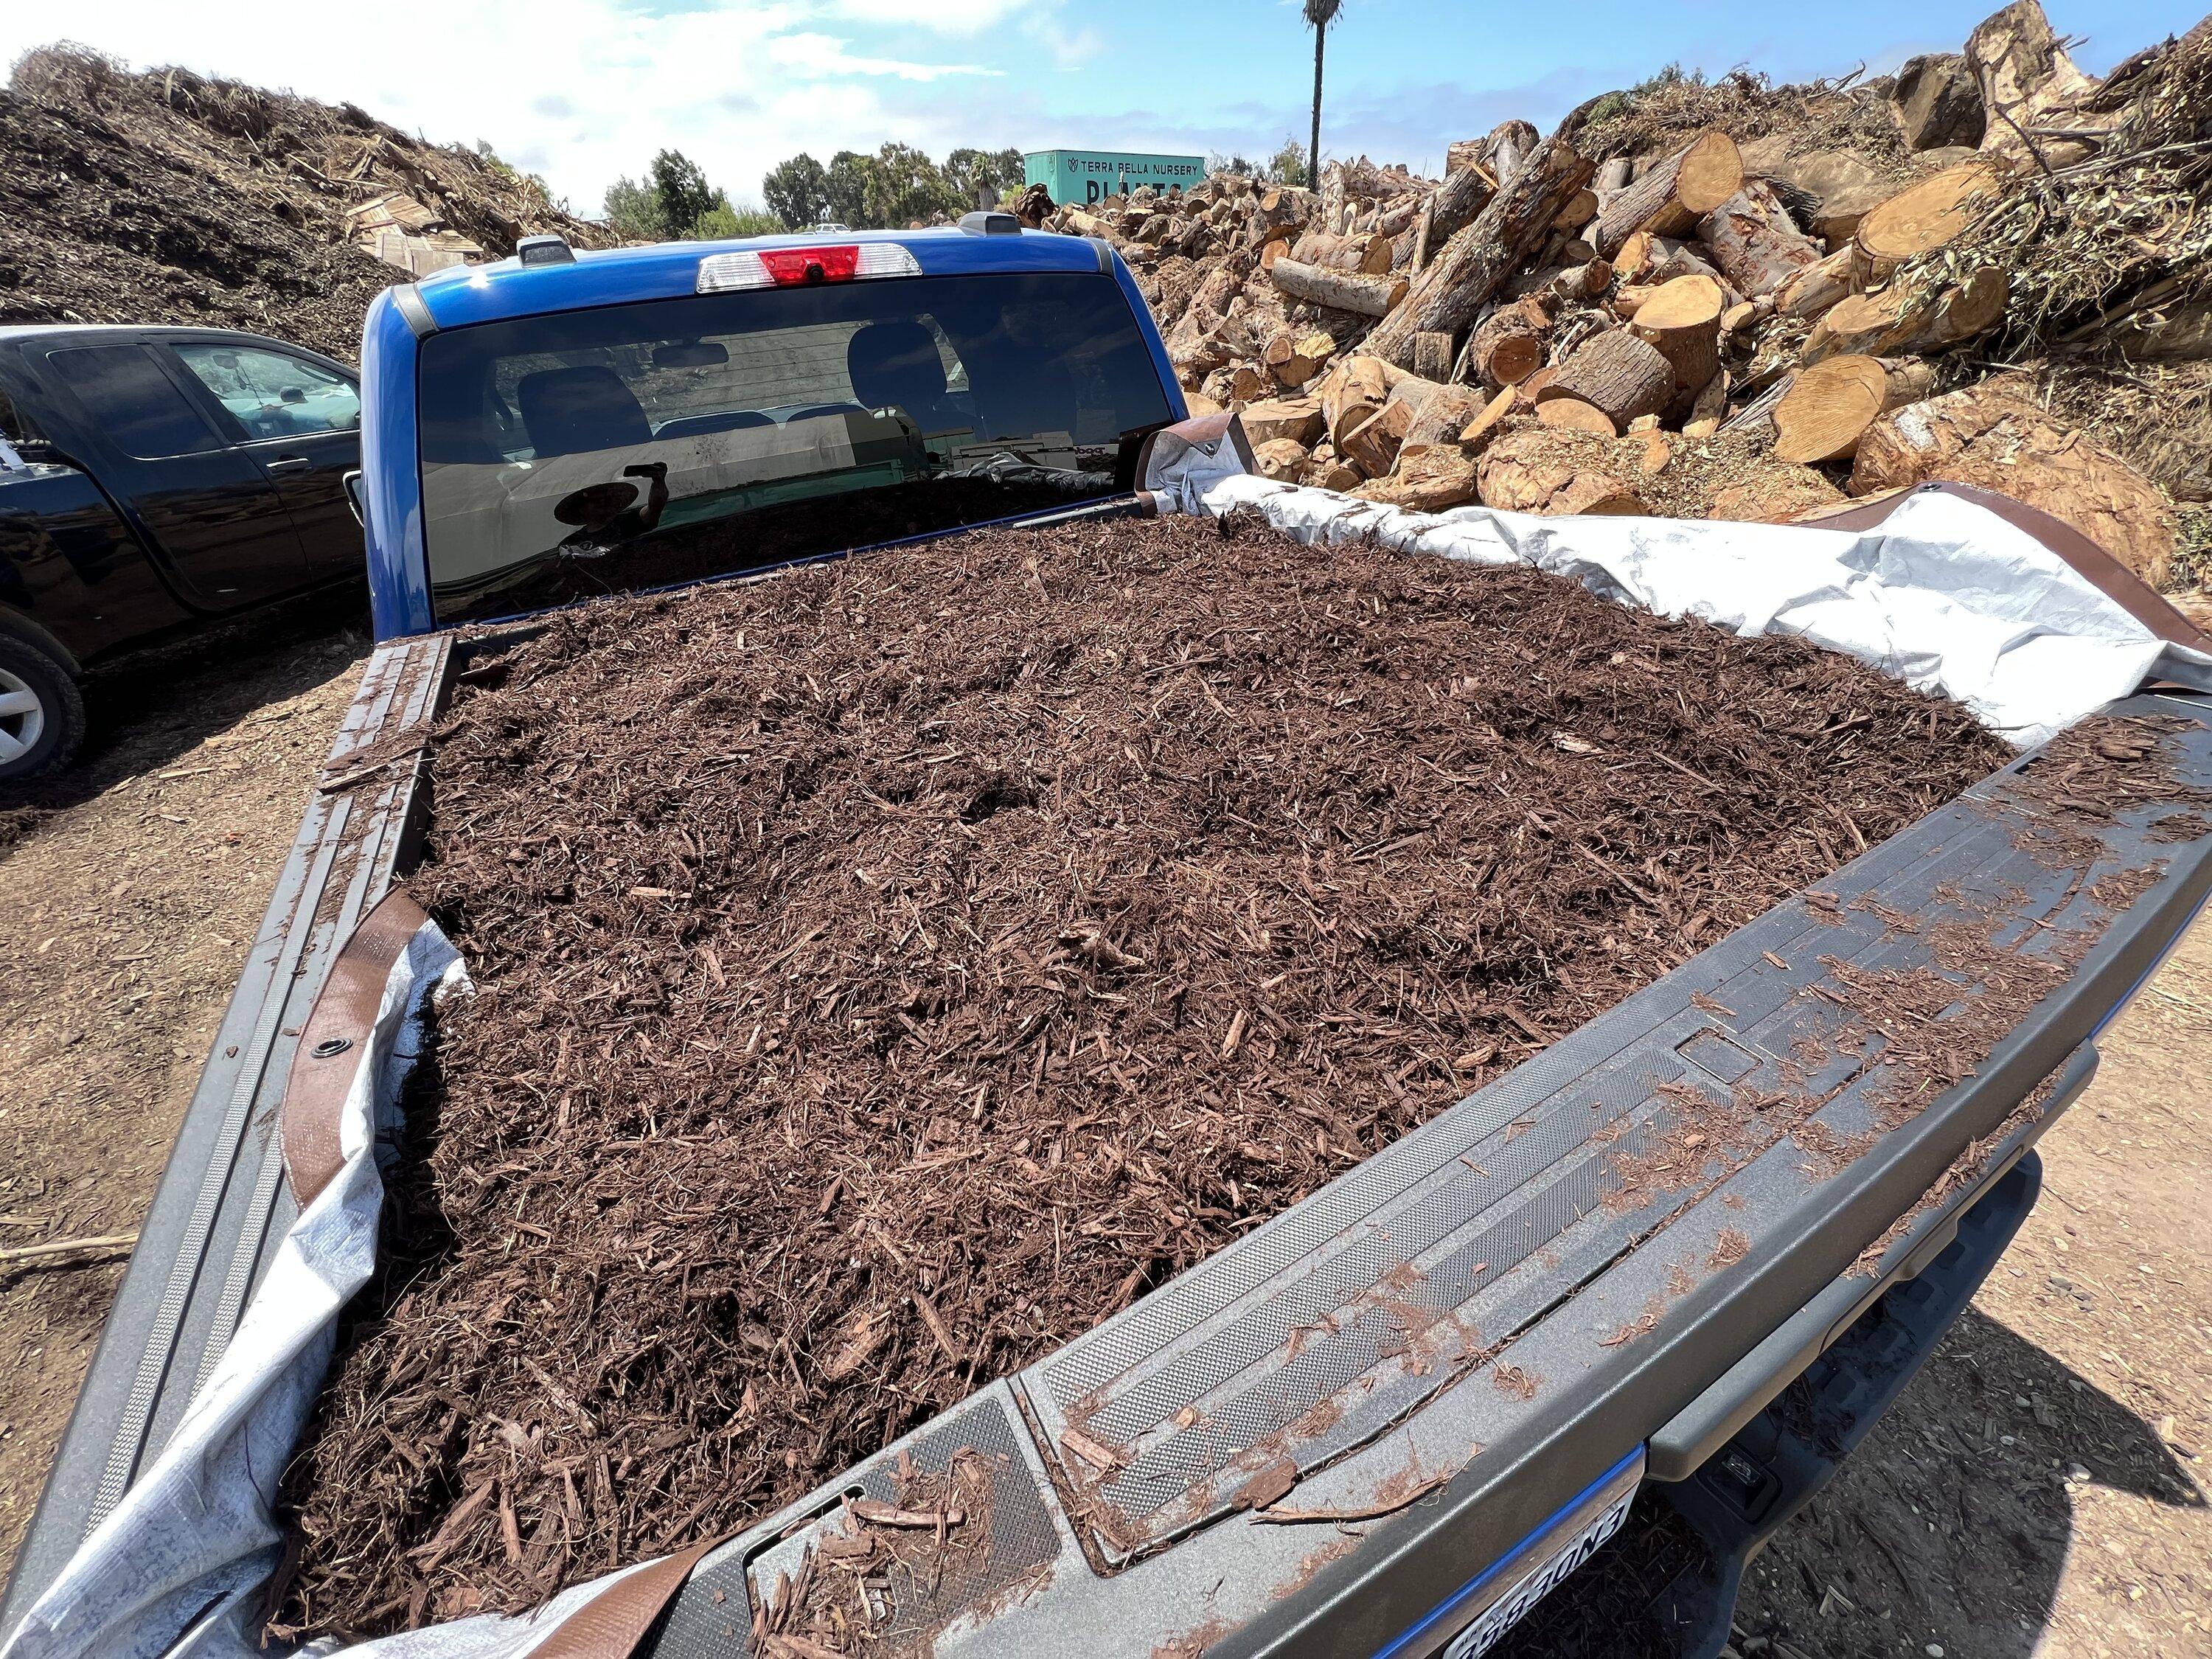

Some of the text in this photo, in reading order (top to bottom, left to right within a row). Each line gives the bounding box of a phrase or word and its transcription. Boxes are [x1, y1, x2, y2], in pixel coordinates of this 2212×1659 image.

[1081, 161, 1197, 175] TERRA BELLA NURSERY
